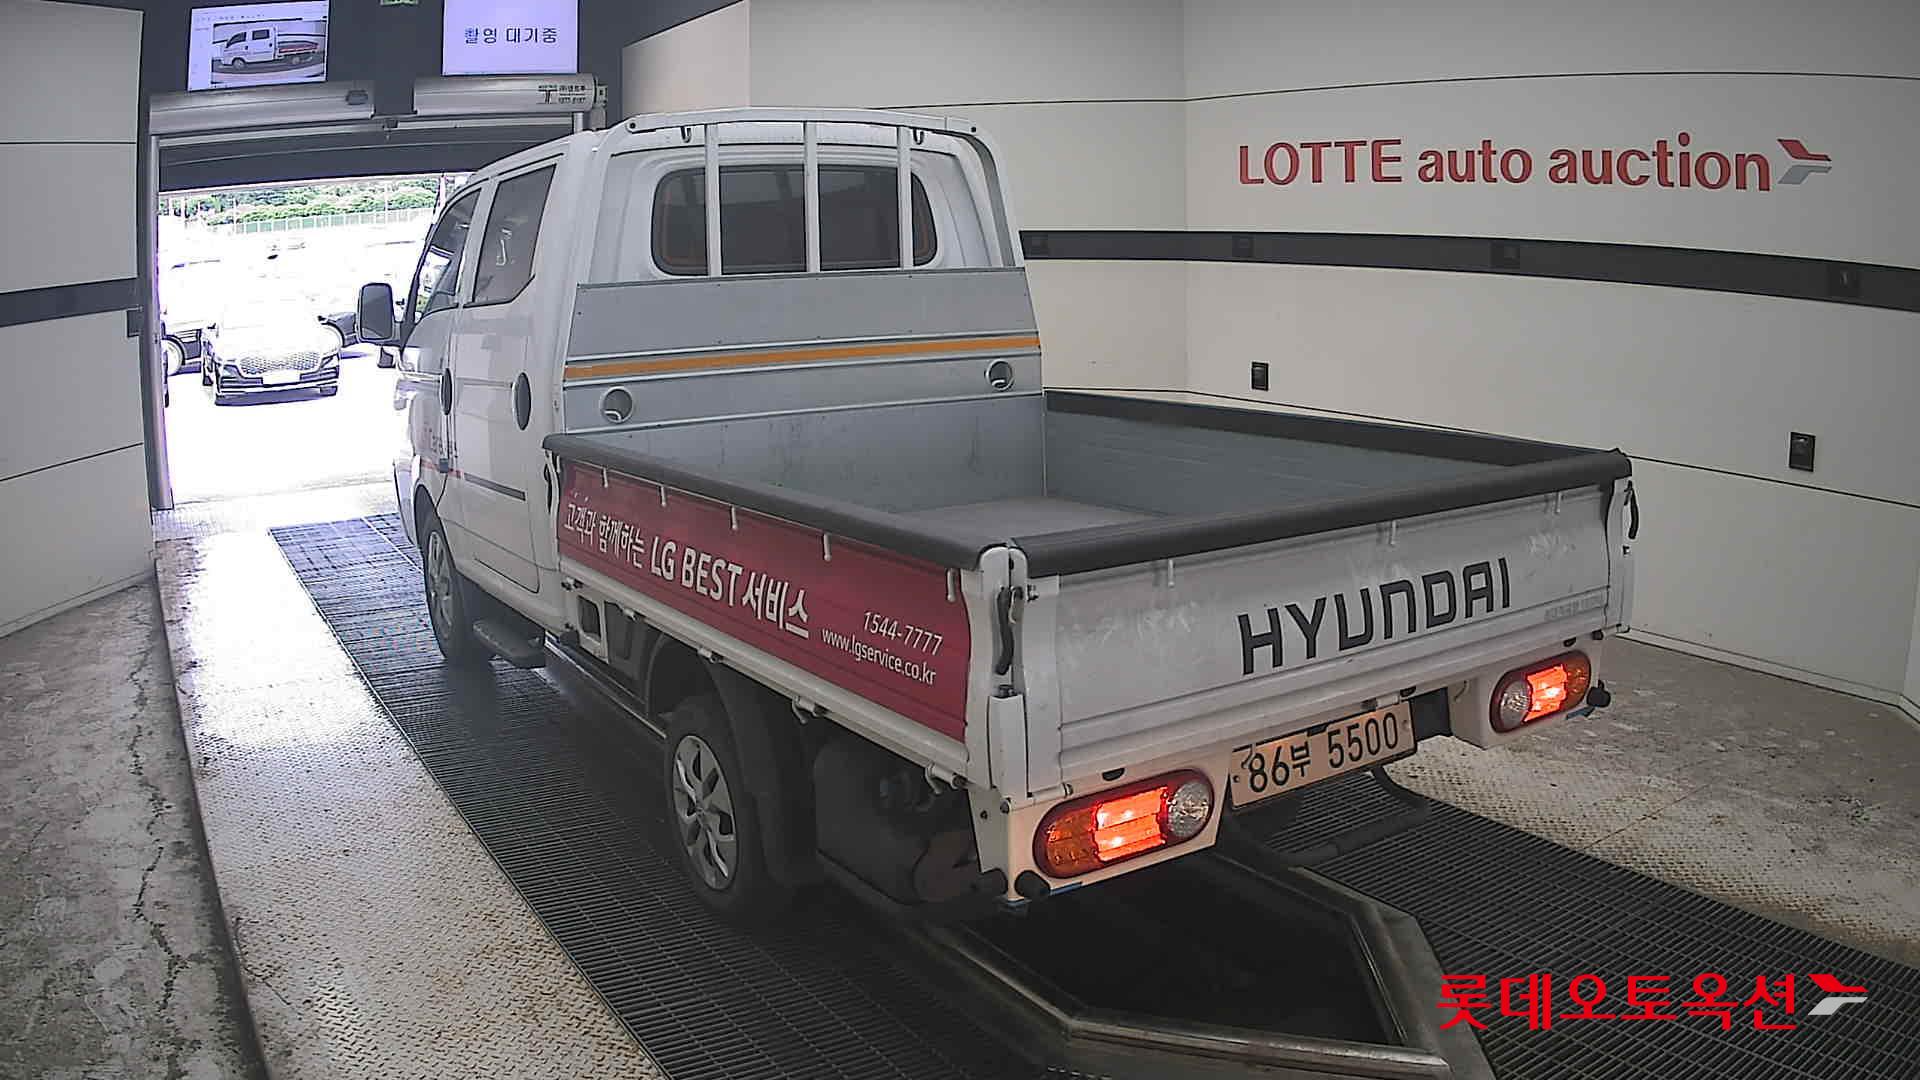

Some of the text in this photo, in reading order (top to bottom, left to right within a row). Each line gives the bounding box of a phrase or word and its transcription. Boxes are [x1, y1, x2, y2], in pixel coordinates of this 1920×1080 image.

[506, 26, 558, 44] 대기중
[1239, 131, 1770, 191] LOTTE auto auction
[564, 503, 809, 639] 고객과 함께하는 LG BEST 서비스
[863, 611, 943, 656] 1544-7777
[1238, 557, 1510, 675] HYUNDAI
[822, 628, 936, 685] www.lgservice.co.kr
[1249, 712, 1399, 793] 86부 5500
